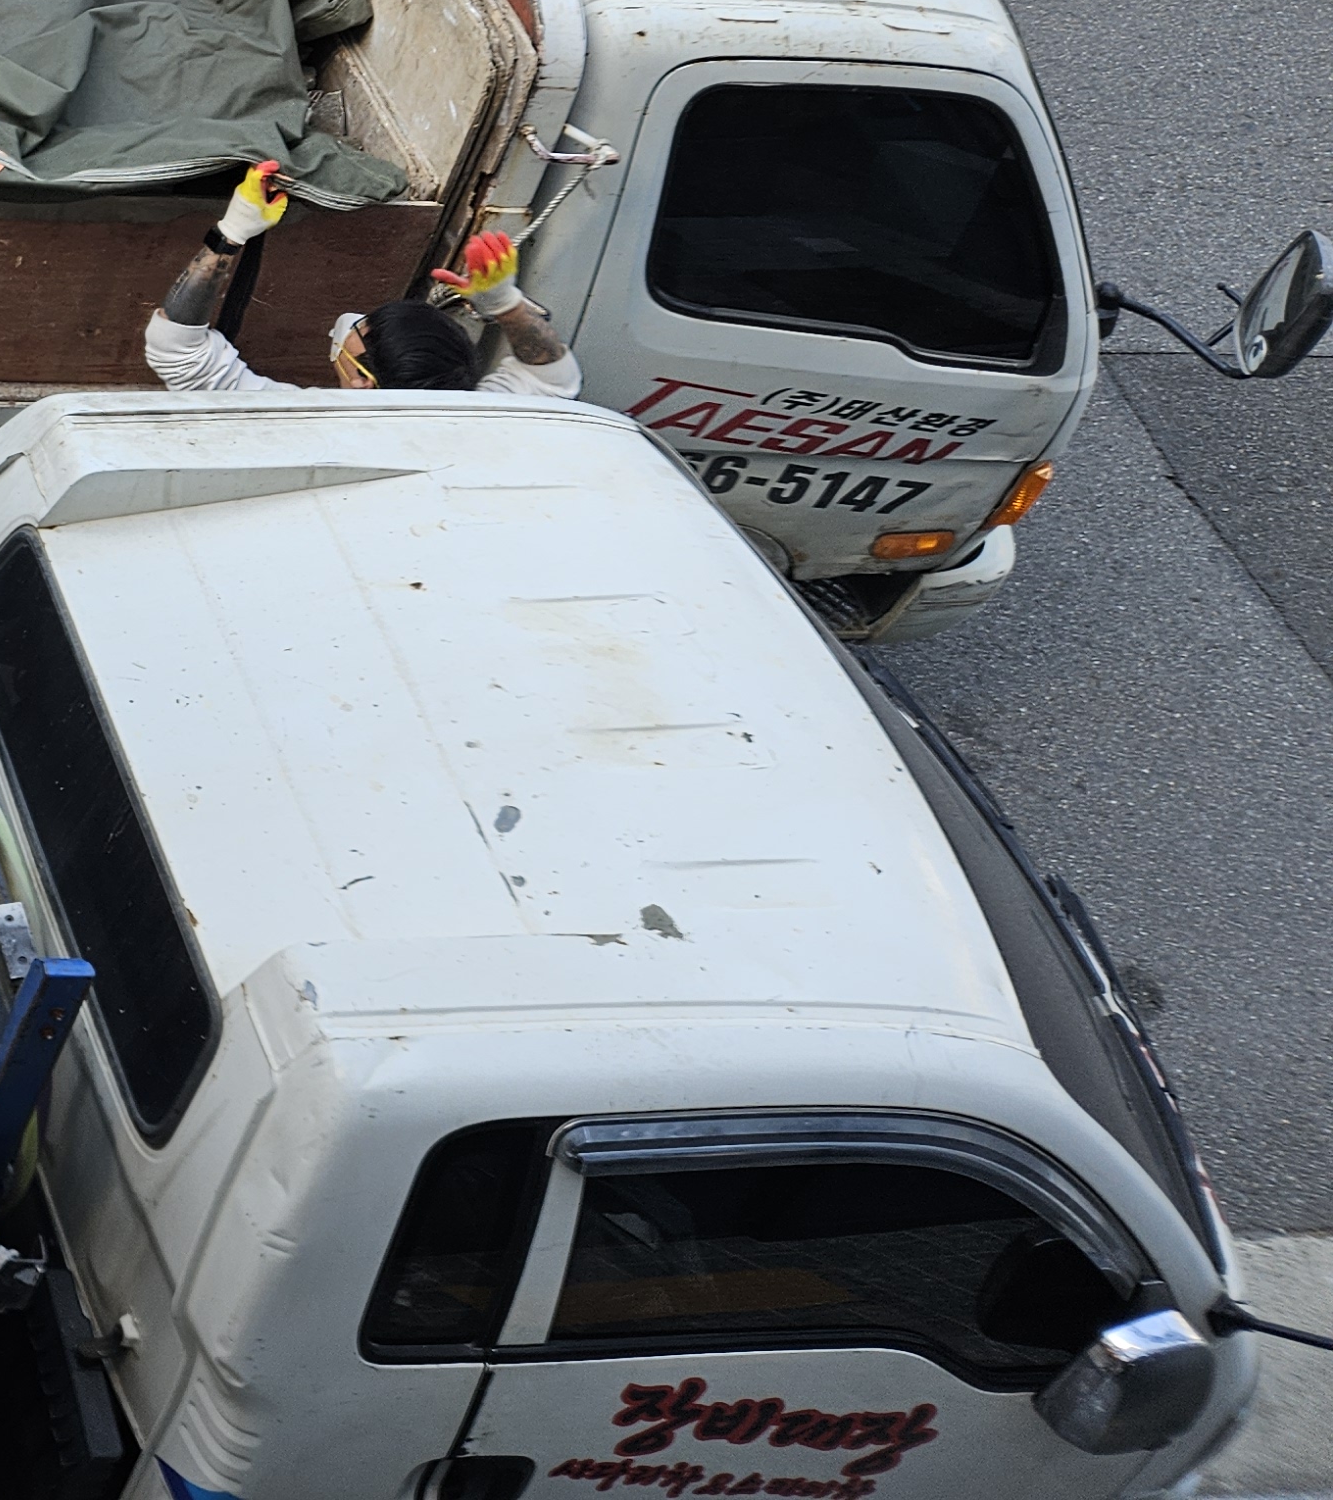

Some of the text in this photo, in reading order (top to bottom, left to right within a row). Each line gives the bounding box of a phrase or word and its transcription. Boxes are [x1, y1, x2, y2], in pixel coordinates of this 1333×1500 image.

[625, 377, 965, 465] TAESAN
[760, 387, 999, 437] (주)태산환경
[679, 451, 934, 514] 6-5147
